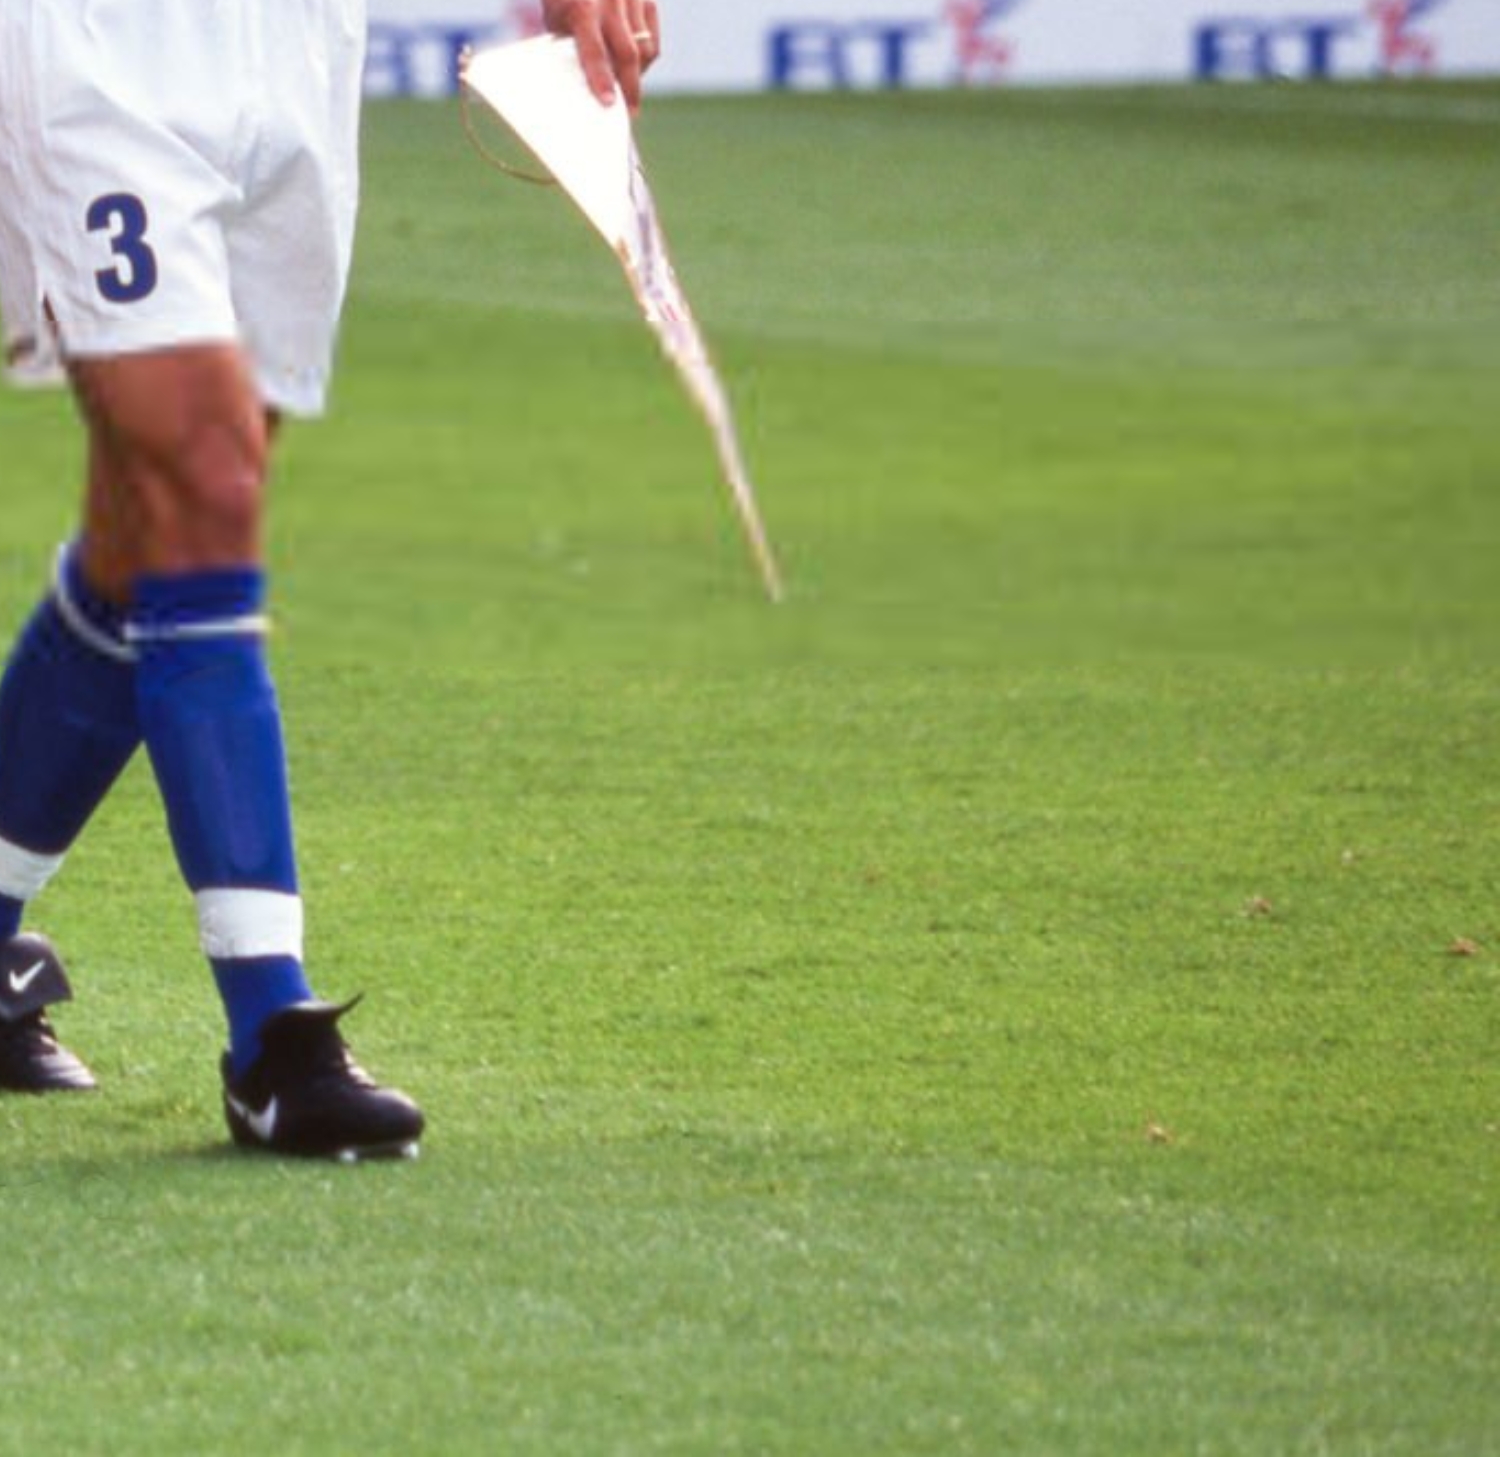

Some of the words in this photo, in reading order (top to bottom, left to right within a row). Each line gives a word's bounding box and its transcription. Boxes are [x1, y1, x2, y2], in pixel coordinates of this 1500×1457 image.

[764, 19, 932, 91] BT
[1193, 15, 1357, 83] BT
[85, 192, 158, 303] 3
